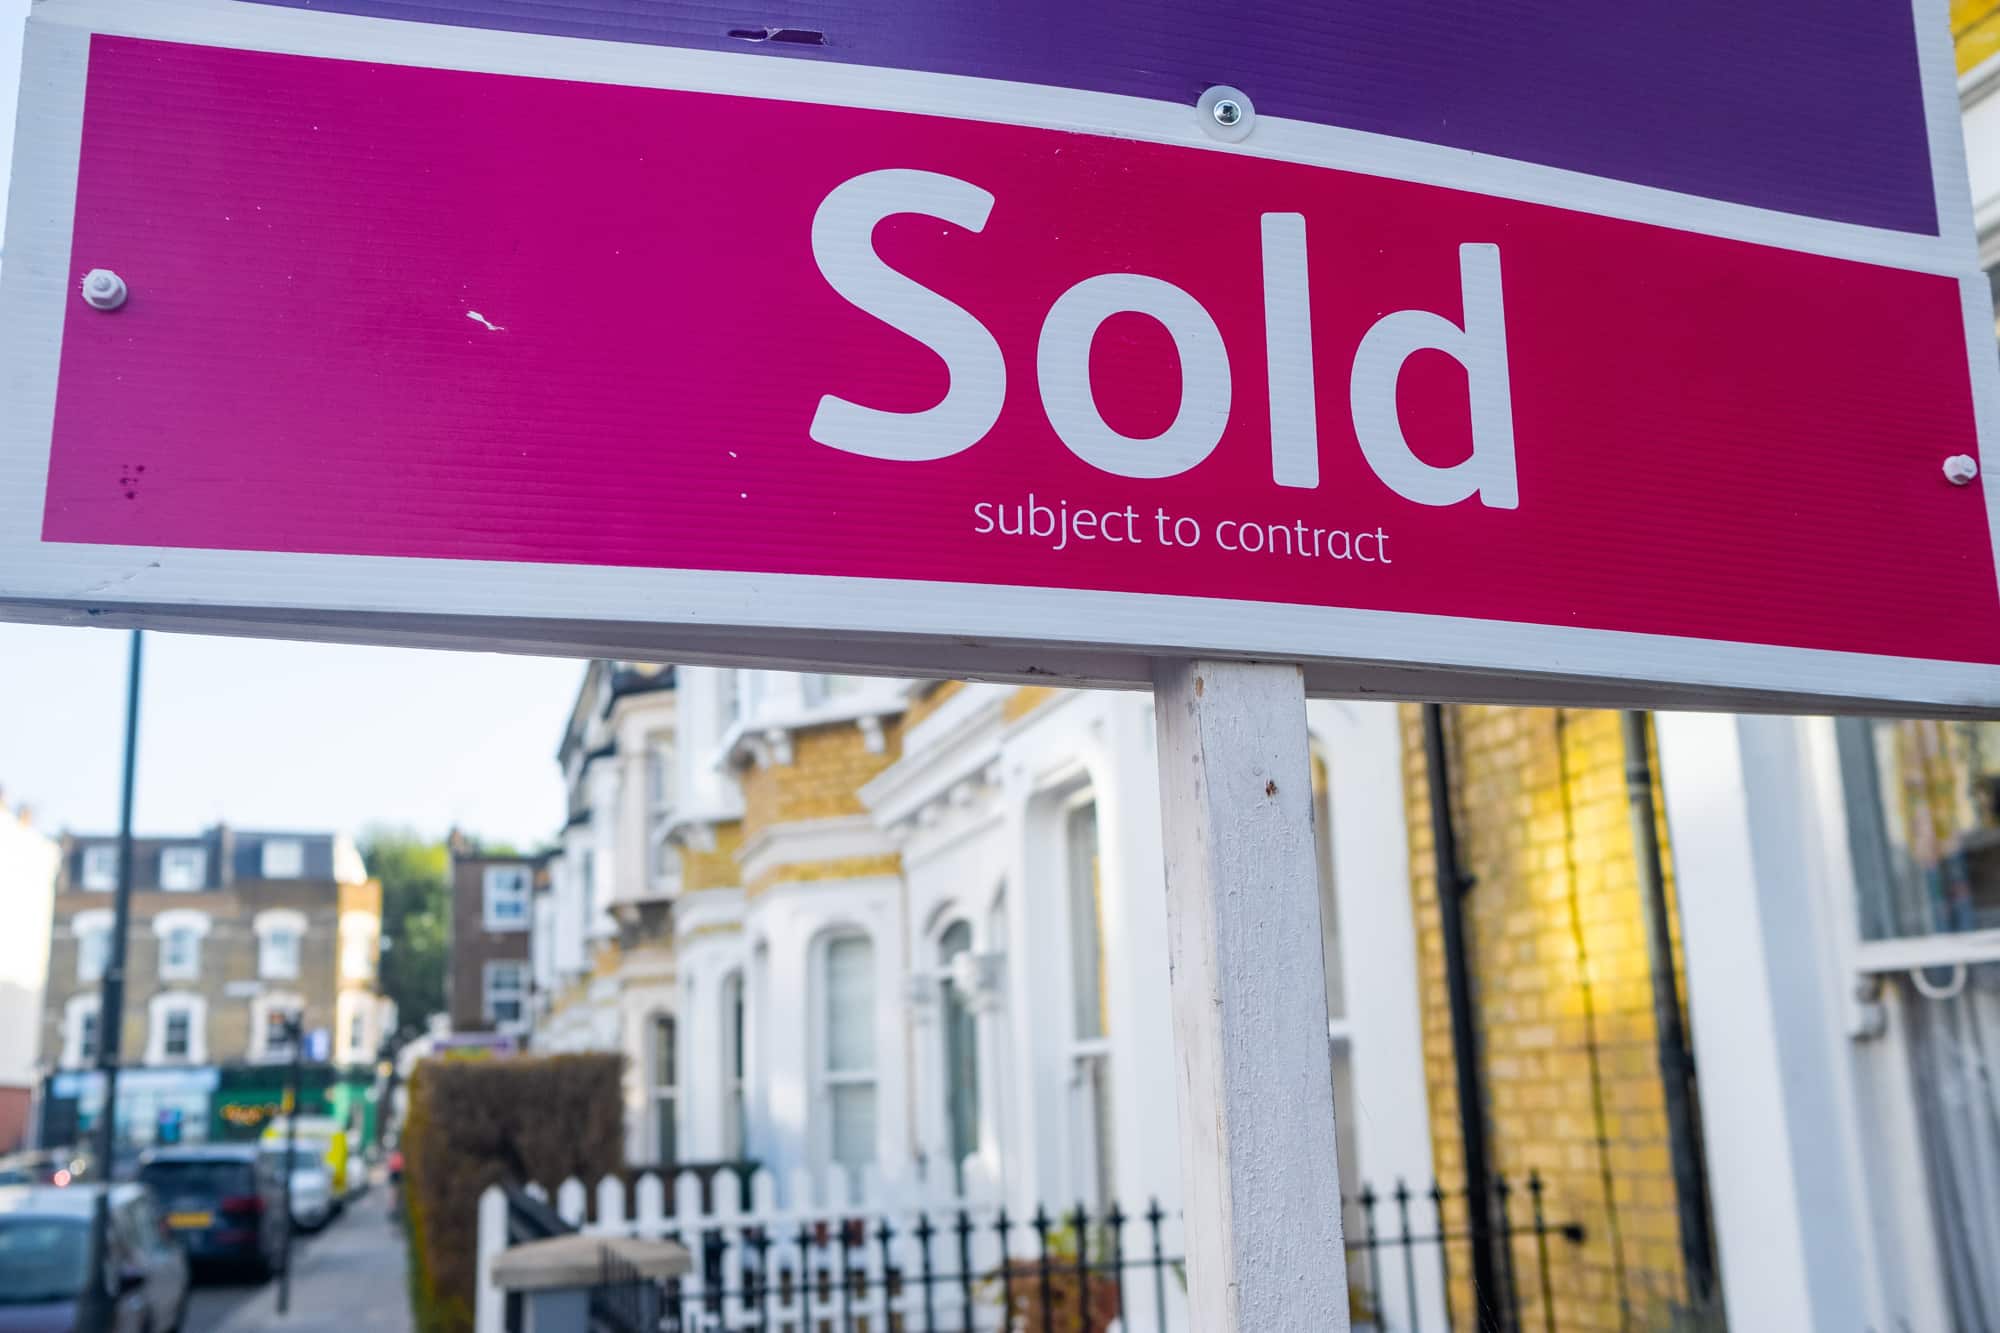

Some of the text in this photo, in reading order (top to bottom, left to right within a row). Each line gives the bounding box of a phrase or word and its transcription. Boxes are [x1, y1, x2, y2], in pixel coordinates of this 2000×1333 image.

[809, 168, 1520, 510] Sold
[974, 494, 1392, 564] subject to contract
